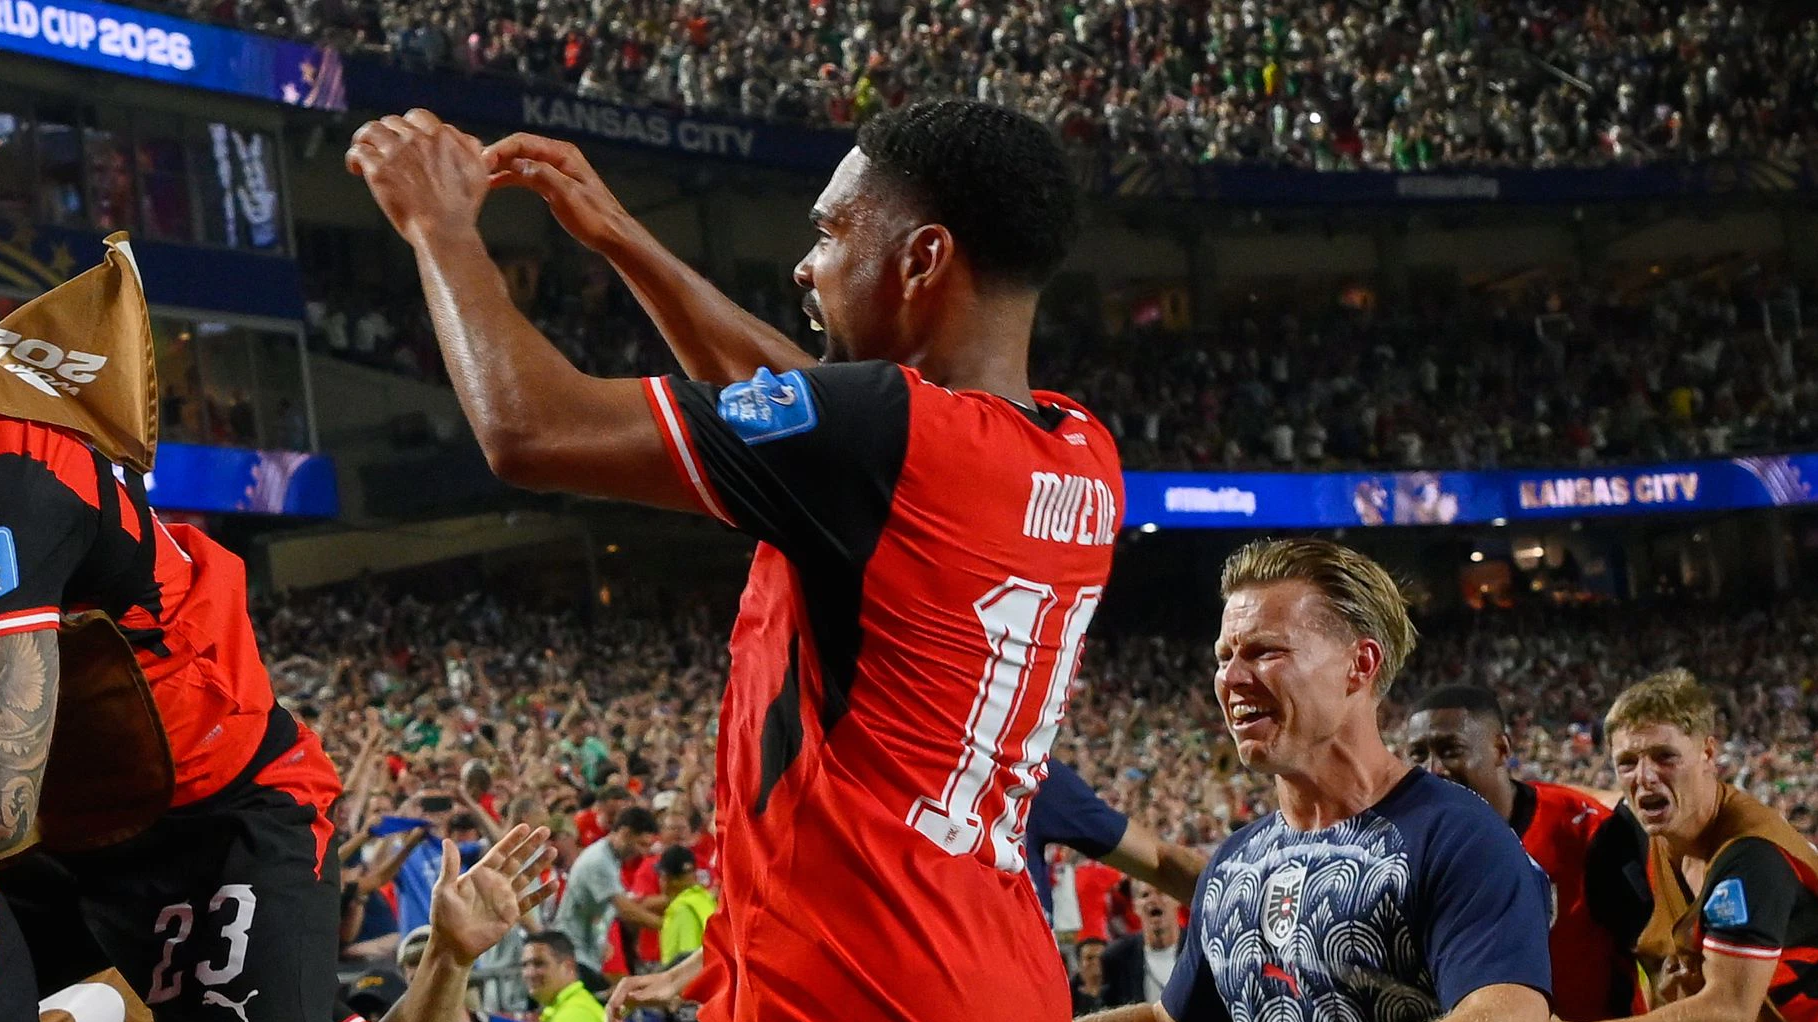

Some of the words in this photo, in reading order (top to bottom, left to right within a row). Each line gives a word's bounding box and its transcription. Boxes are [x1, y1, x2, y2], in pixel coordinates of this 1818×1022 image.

[42, 6, 96, 49] CUP
[99, 18, 194, 71] 2026
[522, 96, 671, 145] KANSAS
[678, 121, 753, 156] CITY
[1520, 476, 1630, 509] KANSAS
[1635, 472, 1698, 503] CITY
[145, 883, 257, 1004] 23
